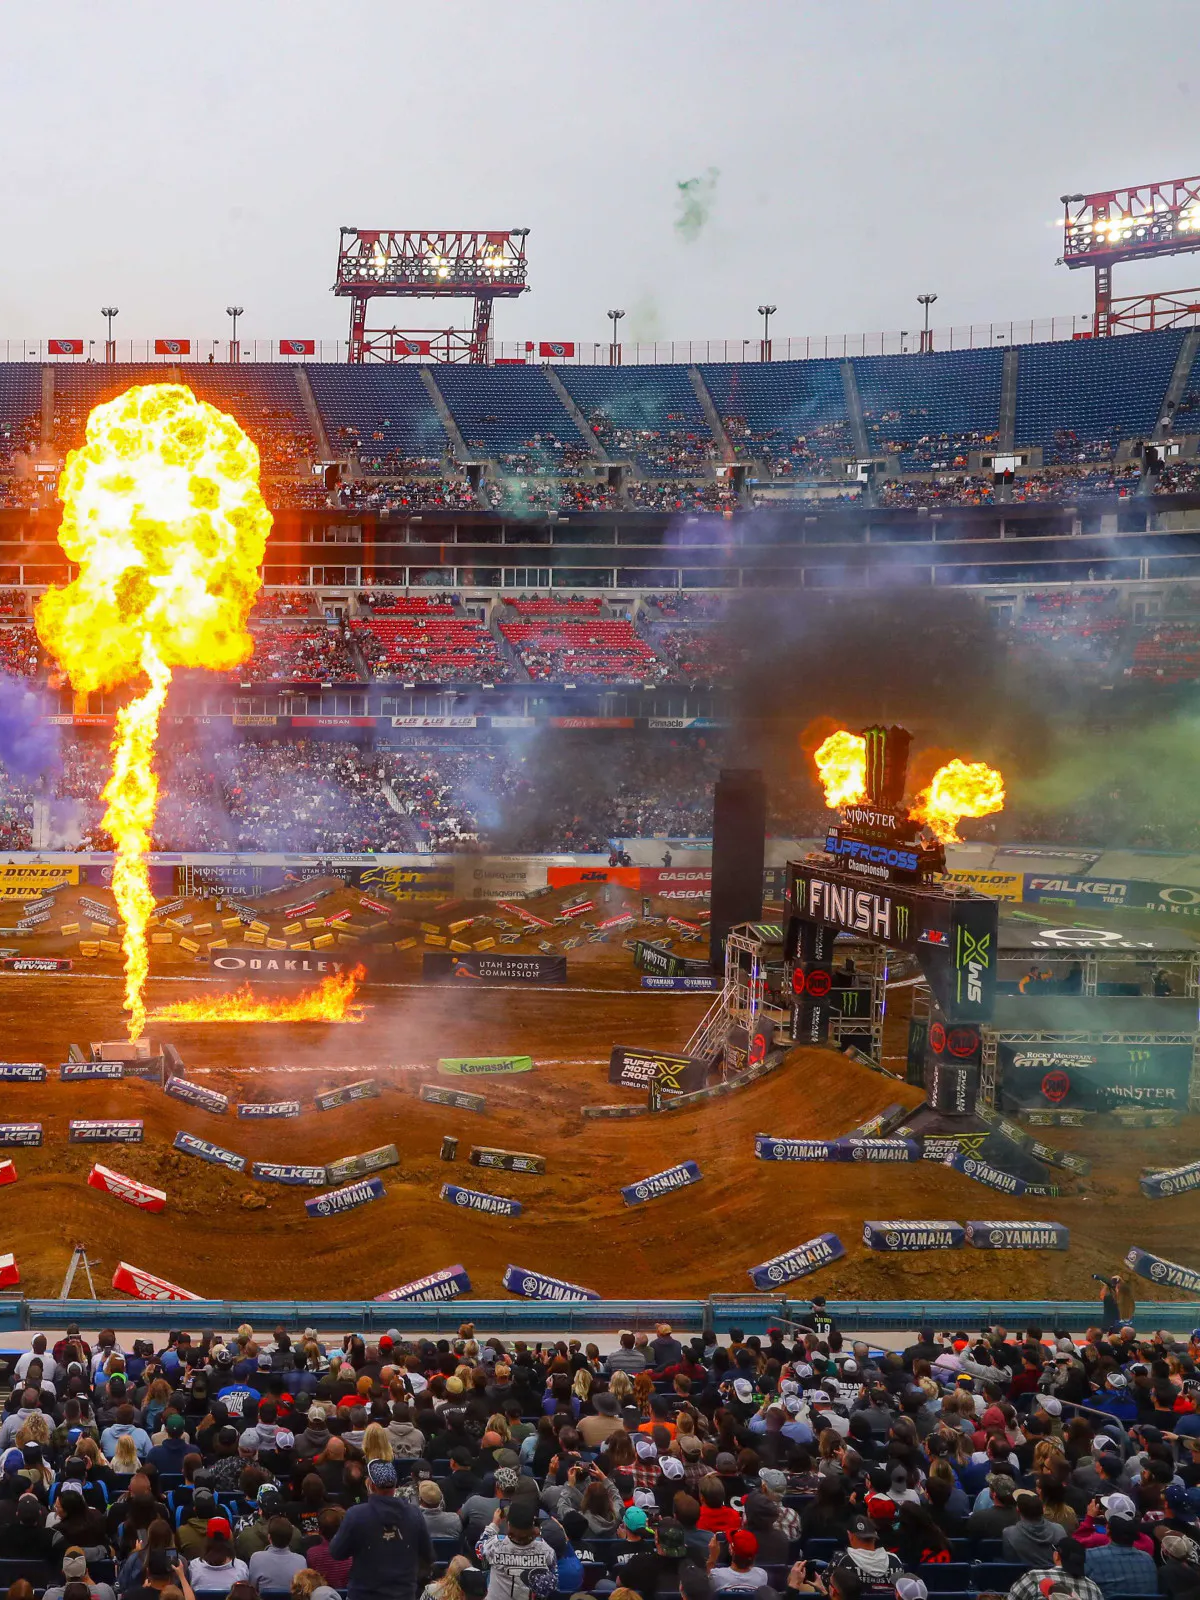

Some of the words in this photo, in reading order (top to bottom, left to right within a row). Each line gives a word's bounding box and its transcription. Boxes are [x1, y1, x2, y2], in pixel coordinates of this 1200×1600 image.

[650, 720, 683, 728] Pinnacle
[846, 807, 896, 829] MONSTER
[826, 837, 919, 871] SUPERCROSS
[4, 869, 72, 877] DUNLOP
[194, 867, 246, 877] MONSTER
[483, 871, 526, 879] Husqvarna
[580, 872, 607, 880] KTM
[658, 872, 712, 880] GASGAS
[849, 859, 889, 880] Championship
[939, 873, 1017, 884] DUNLOP
[1029, 879, 1128, 895] FALKEN
[1102, 896, 1123, 904] TIRES
[810, 879, 890, 940] FINISH
[1147, 903, 1200, 916] OAKLE
[250, 959, 344, 972] OAKLEY
[480, 961, 502, 969] UTAH
[507, 962, 540, 970] SPORTS
[65, 1064, 123, 1074] FALKEN
[460, 1061, 513, 1074] Kawasaki
[623, 1058, 658, 1068] SUPER
[624, 1065, 655, 1075] MOTO
[170, 1086, 226, 1109] FALKEN
[242, 1102, 299, 1115] FALKEN
[74, 1128, 141, 1137] FALKEN
[180, 1135, 245, 1166] FALKEN
[786, 1145, 828, 1158] YAMAHA
[866, 1149, 908, 1160] YAMAHA
[260, 1168, 325, 1178] FALKEN
[975, 1164, 1016, 1191] YAMAHA
[646, 1168, 691, 1193] YAMAHA
[103, 1176, 156, 1203] FLY
[329, 1186, 374, 1209] YAMAHA
[468, 1194, 512, 1215] YAMAHA
[902, 1232, 952, 1245] YAMAHA
[1005, 1231, 1057, 1244] YAMAHA
[780, 1242, 832, 1274] YAMAHA
[494, 1554, 547, 1567] CARMICHAEL
